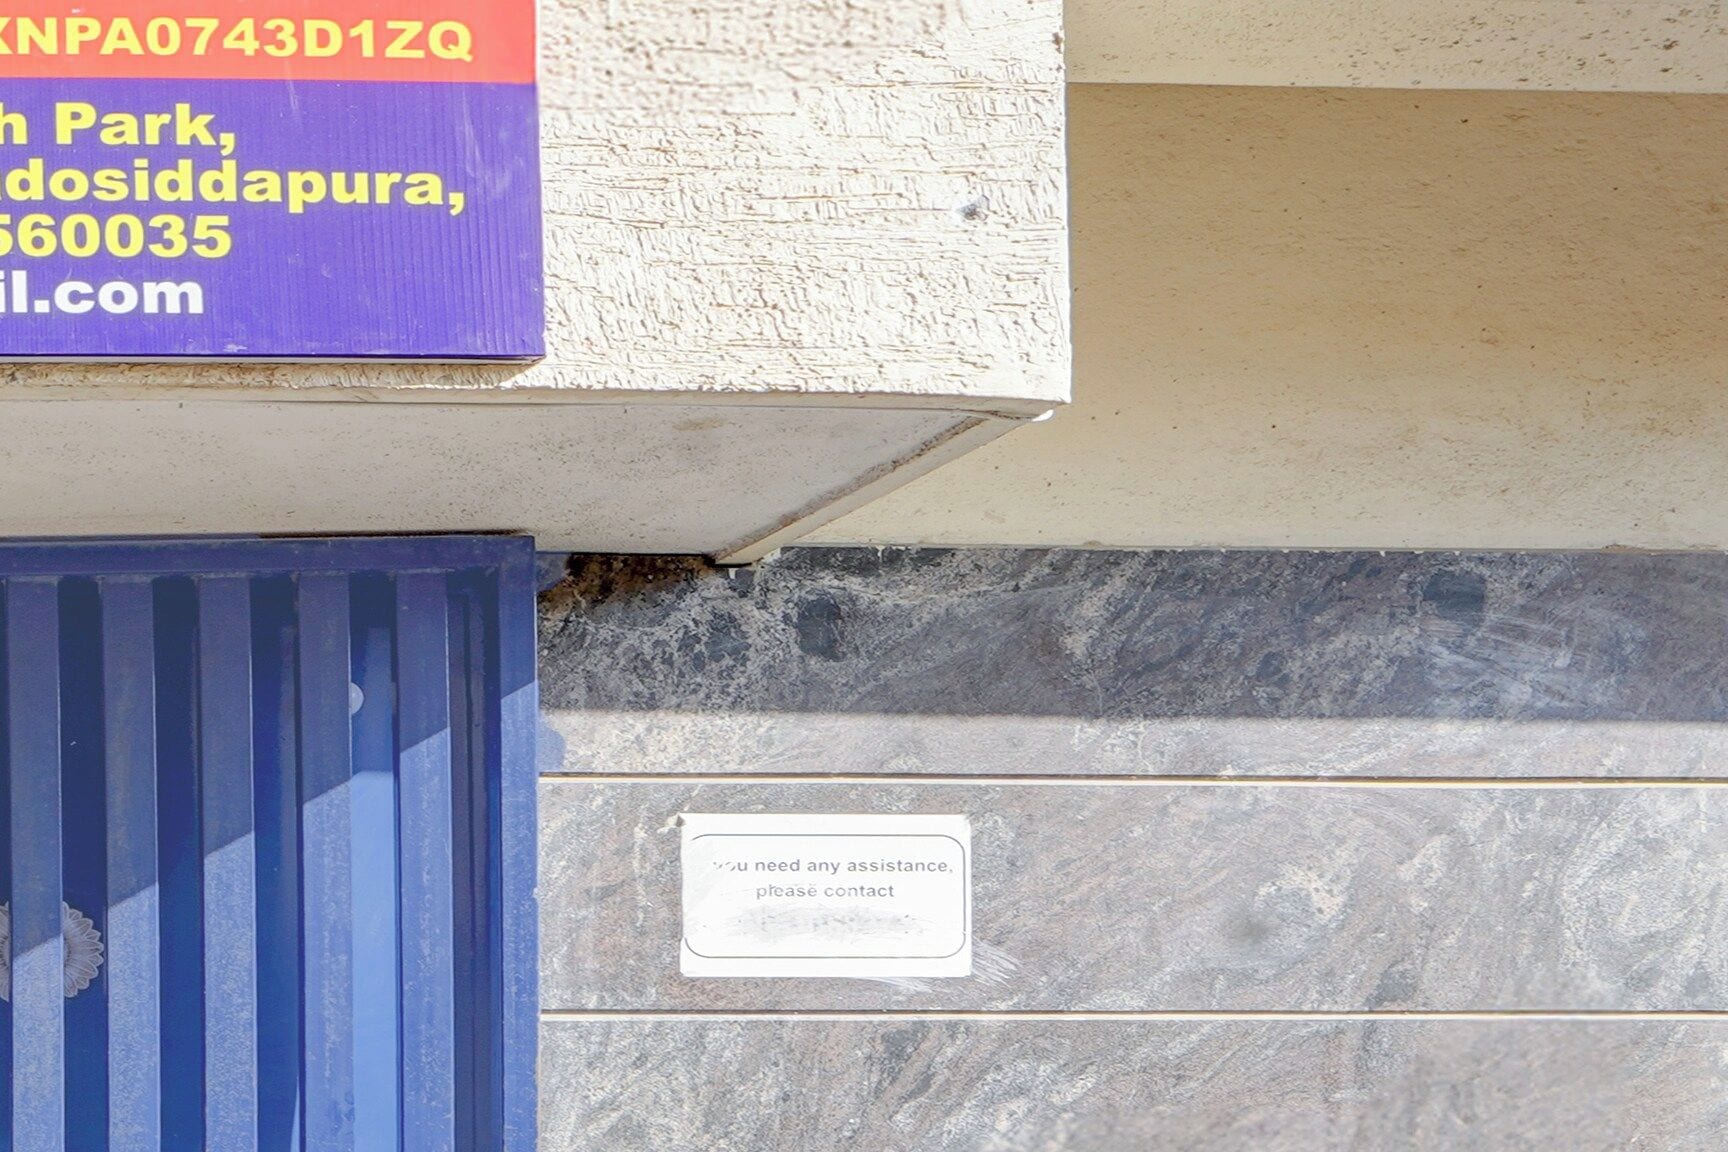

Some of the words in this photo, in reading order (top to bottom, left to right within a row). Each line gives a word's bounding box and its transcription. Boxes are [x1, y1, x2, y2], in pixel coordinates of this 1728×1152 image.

[54, 100, 237, 158] Park,
[755, 859, 800, 872] need
[807, 861, 840, 875] any
[824, 884, 895, 898] contact
